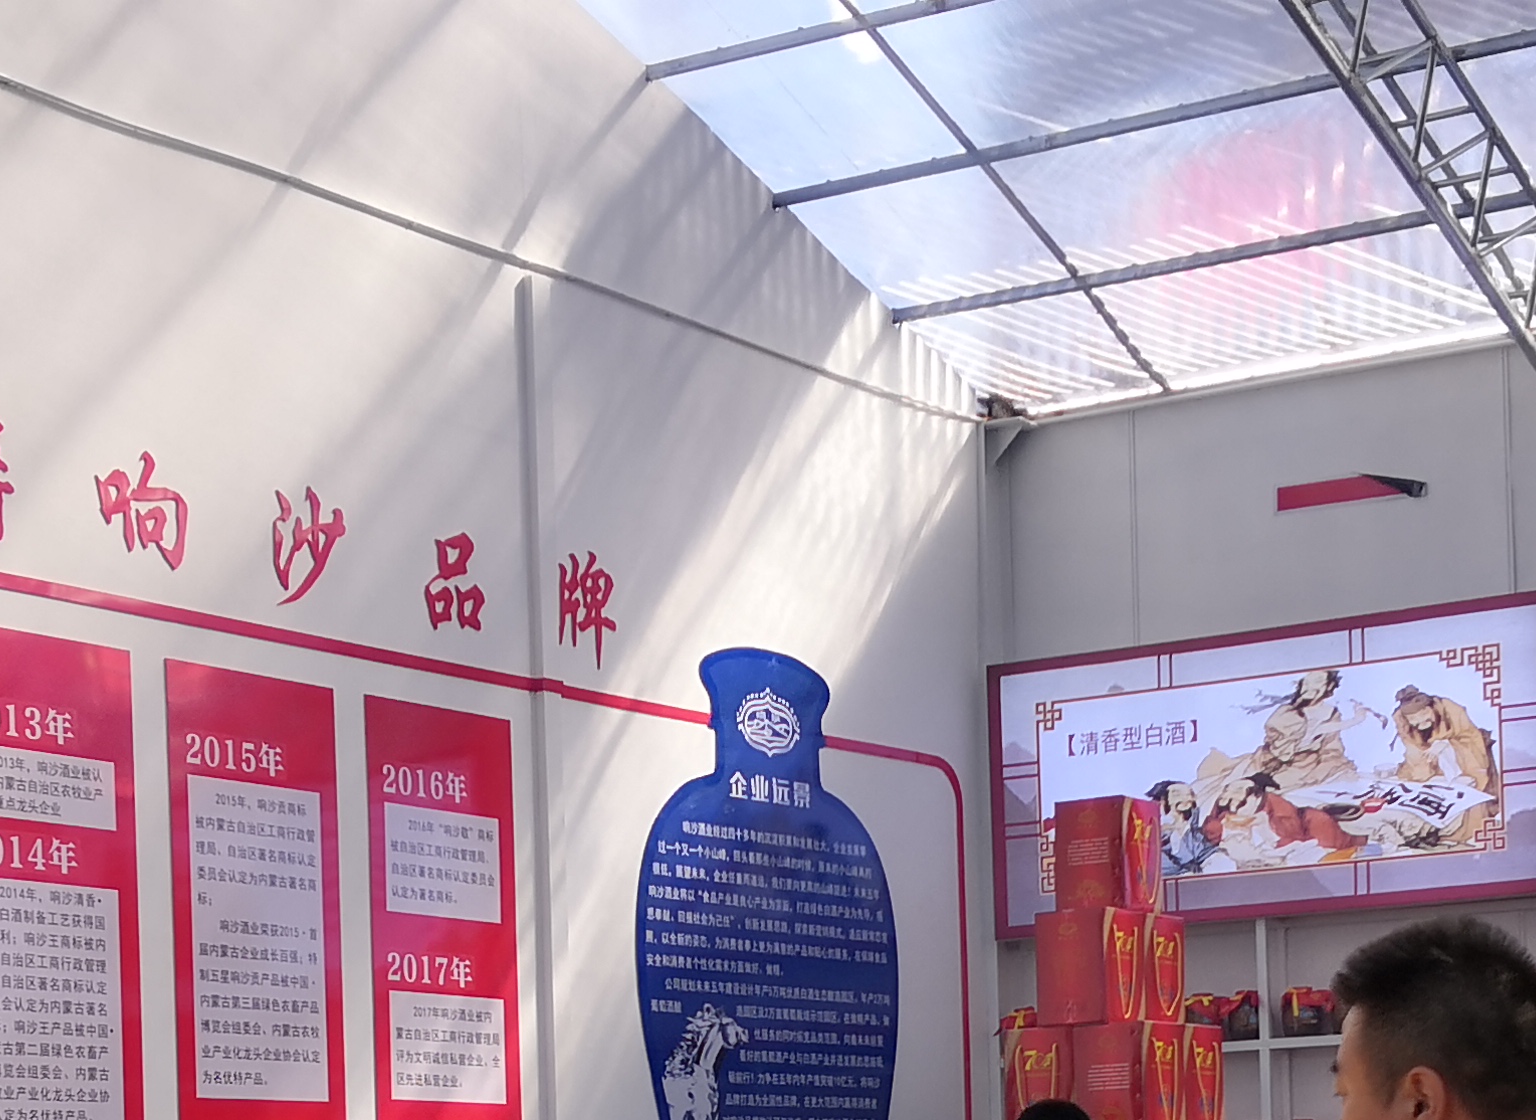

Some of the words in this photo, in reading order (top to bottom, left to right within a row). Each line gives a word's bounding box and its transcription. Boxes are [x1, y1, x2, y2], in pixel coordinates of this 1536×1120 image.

[185, 733, 284, 778] 2015年
[1067, 718, 1198, 758] 【清香型白酒】
[382, 764, 468, 804] 2016年
[729, 771, 811, 809] 企业远景
[387, 952, 473, 988] 2017年
